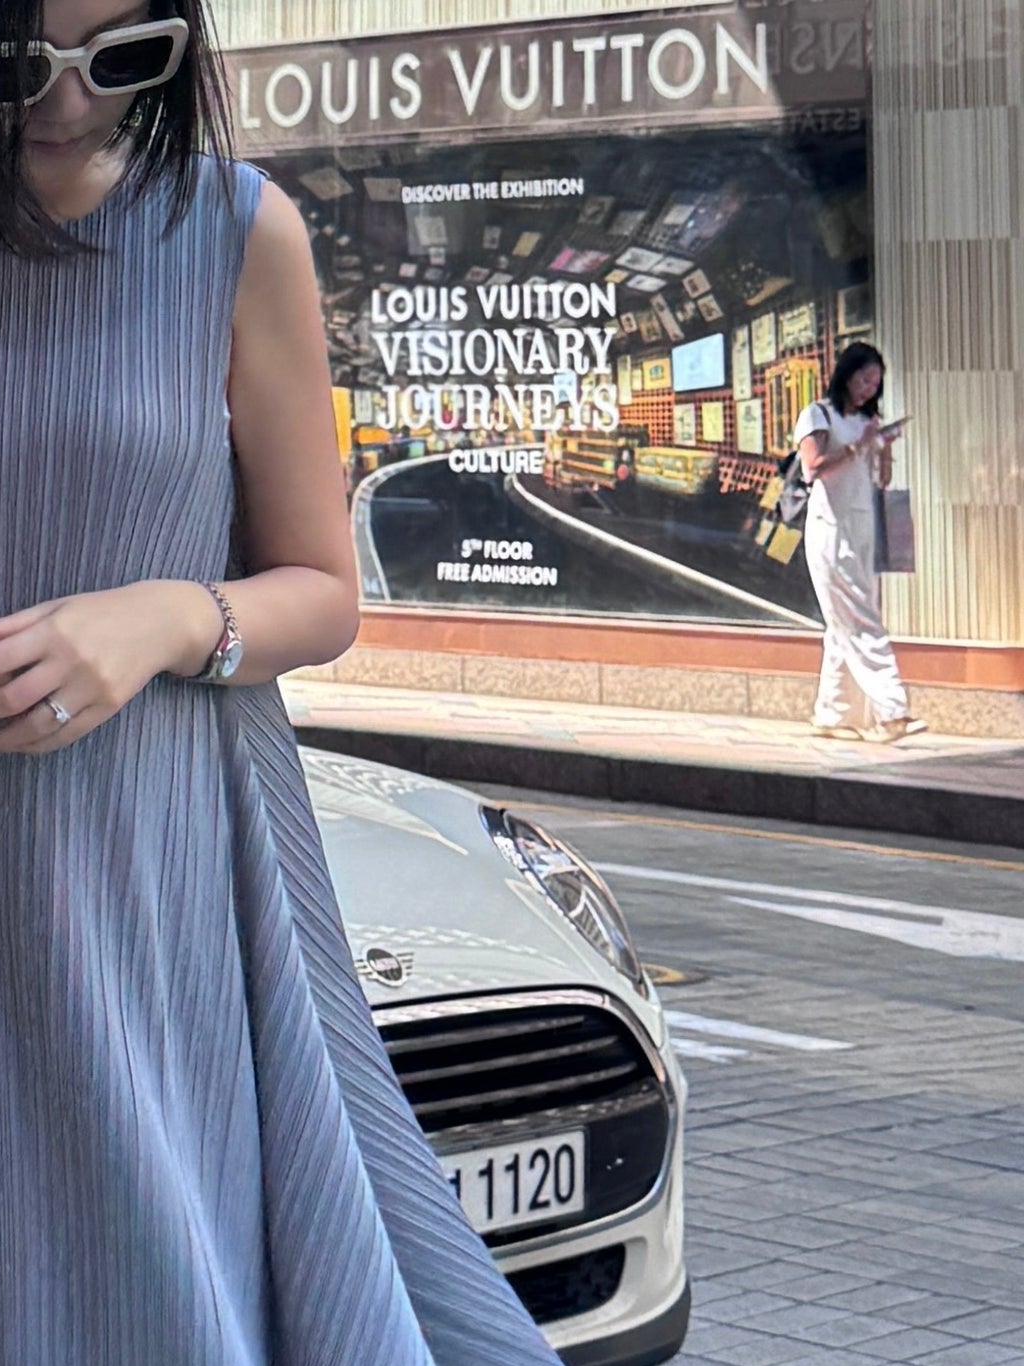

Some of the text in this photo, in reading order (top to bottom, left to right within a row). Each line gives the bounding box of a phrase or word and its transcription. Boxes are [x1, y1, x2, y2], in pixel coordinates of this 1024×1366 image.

[239, 53, 421, 129] LOUIS
[449, 22, 768, 116] VUITTON
[401, 178, 585, 204] DISCOVER THE EXHIBITION
[371, 282, 617, 324] LOUIS VUITTON
[372, 327, 618, 377] VISIONARY
[376, 382, 620, 433] JOURNEYS
[448, 448, 545, 475] CULTURE
[483, 540, 534, 560] FLOOR
[437, 562, 558, 587] FREE ADMISSION
[478, 1144, 576, 1220] 1120
